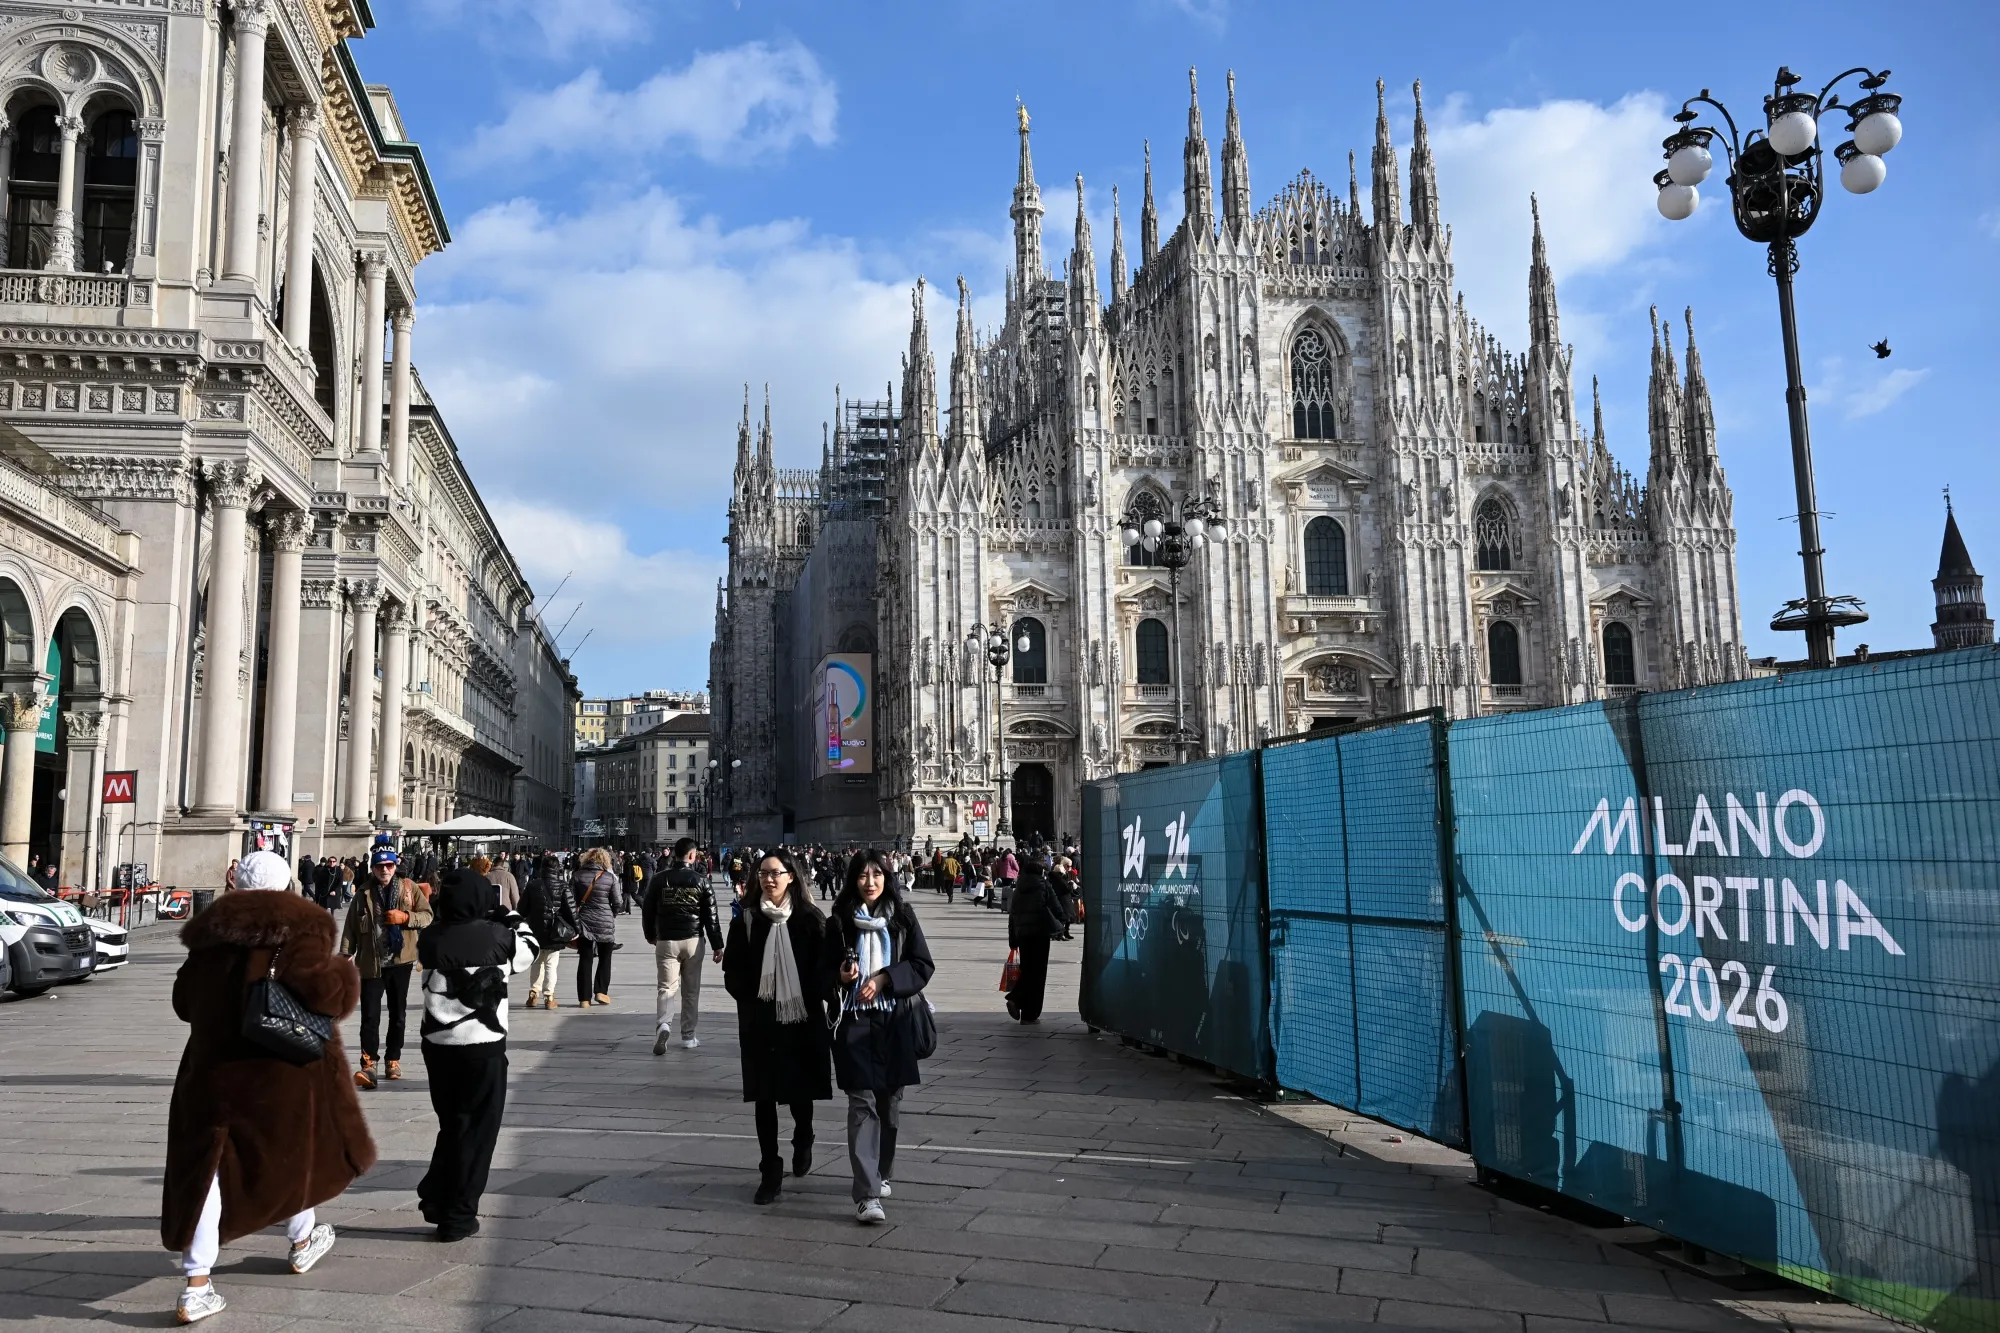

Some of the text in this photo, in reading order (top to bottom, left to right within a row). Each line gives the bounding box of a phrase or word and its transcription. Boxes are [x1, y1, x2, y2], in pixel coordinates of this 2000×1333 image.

[105, 778, 131, 797] M
[974, 803, 987, 814] M
[1571, 788, 1826, 859] MILANO
[1612, 871, 1907, 957] CORTINA
[1658, 953, 1790, 1034] 2026
